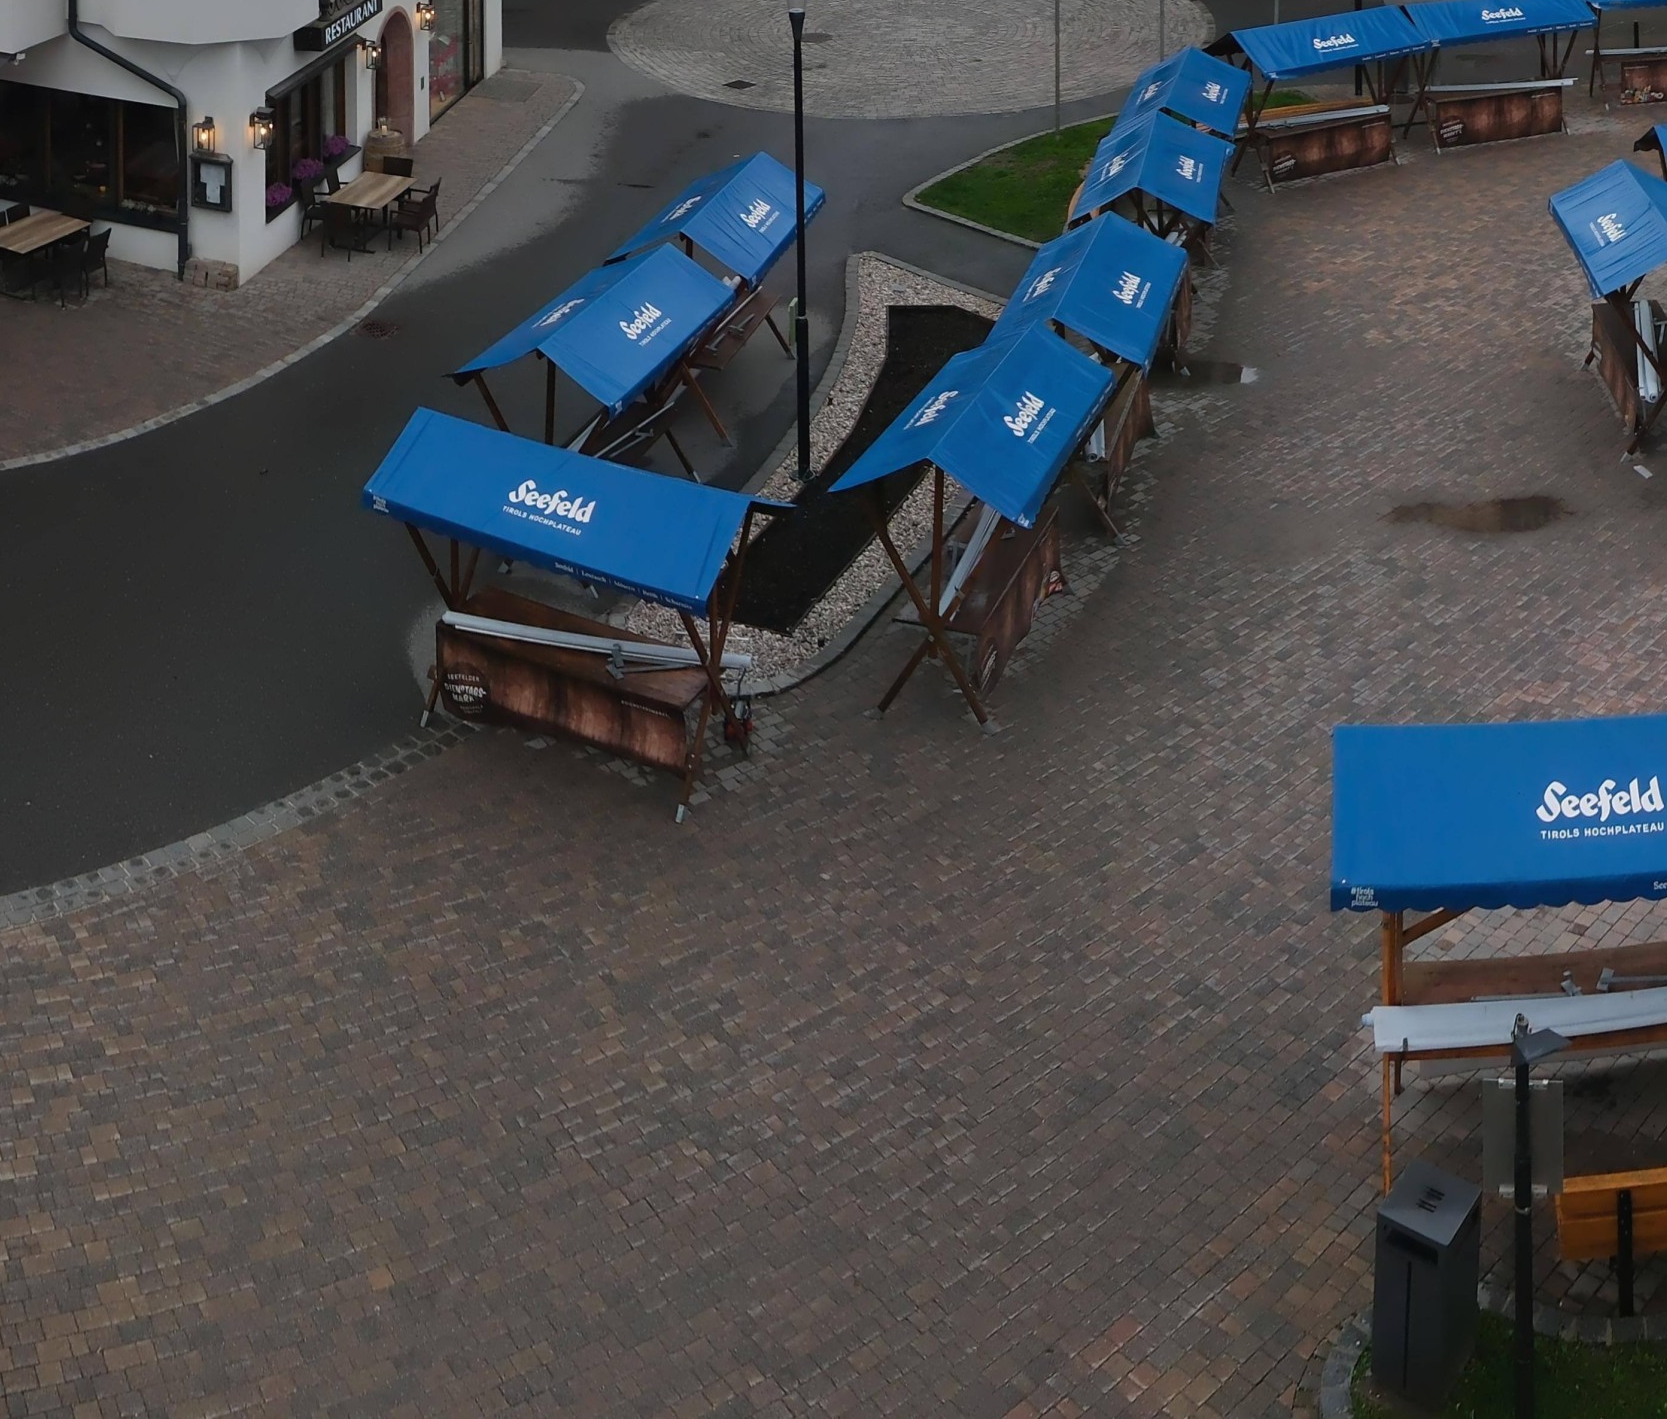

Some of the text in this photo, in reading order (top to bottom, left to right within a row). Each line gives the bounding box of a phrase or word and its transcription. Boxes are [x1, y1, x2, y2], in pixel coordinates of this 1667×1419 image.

[1481, 7, 1523, 22] Seefeld
[1313, 33, 1356, 50] Seefeld
[619, 301, 662, 340] Seefeld
[1003, 390, 1045, 437] Seefeld
[508, 478, 597, 525] Seefeld
[502, 505, 582, 536] TIROLS HOCHPLATEAU
[1535, 775, 1666, 824] Seefeld
[1540, 821, 1666, 840] TIROLS HOCHPLATEAU
